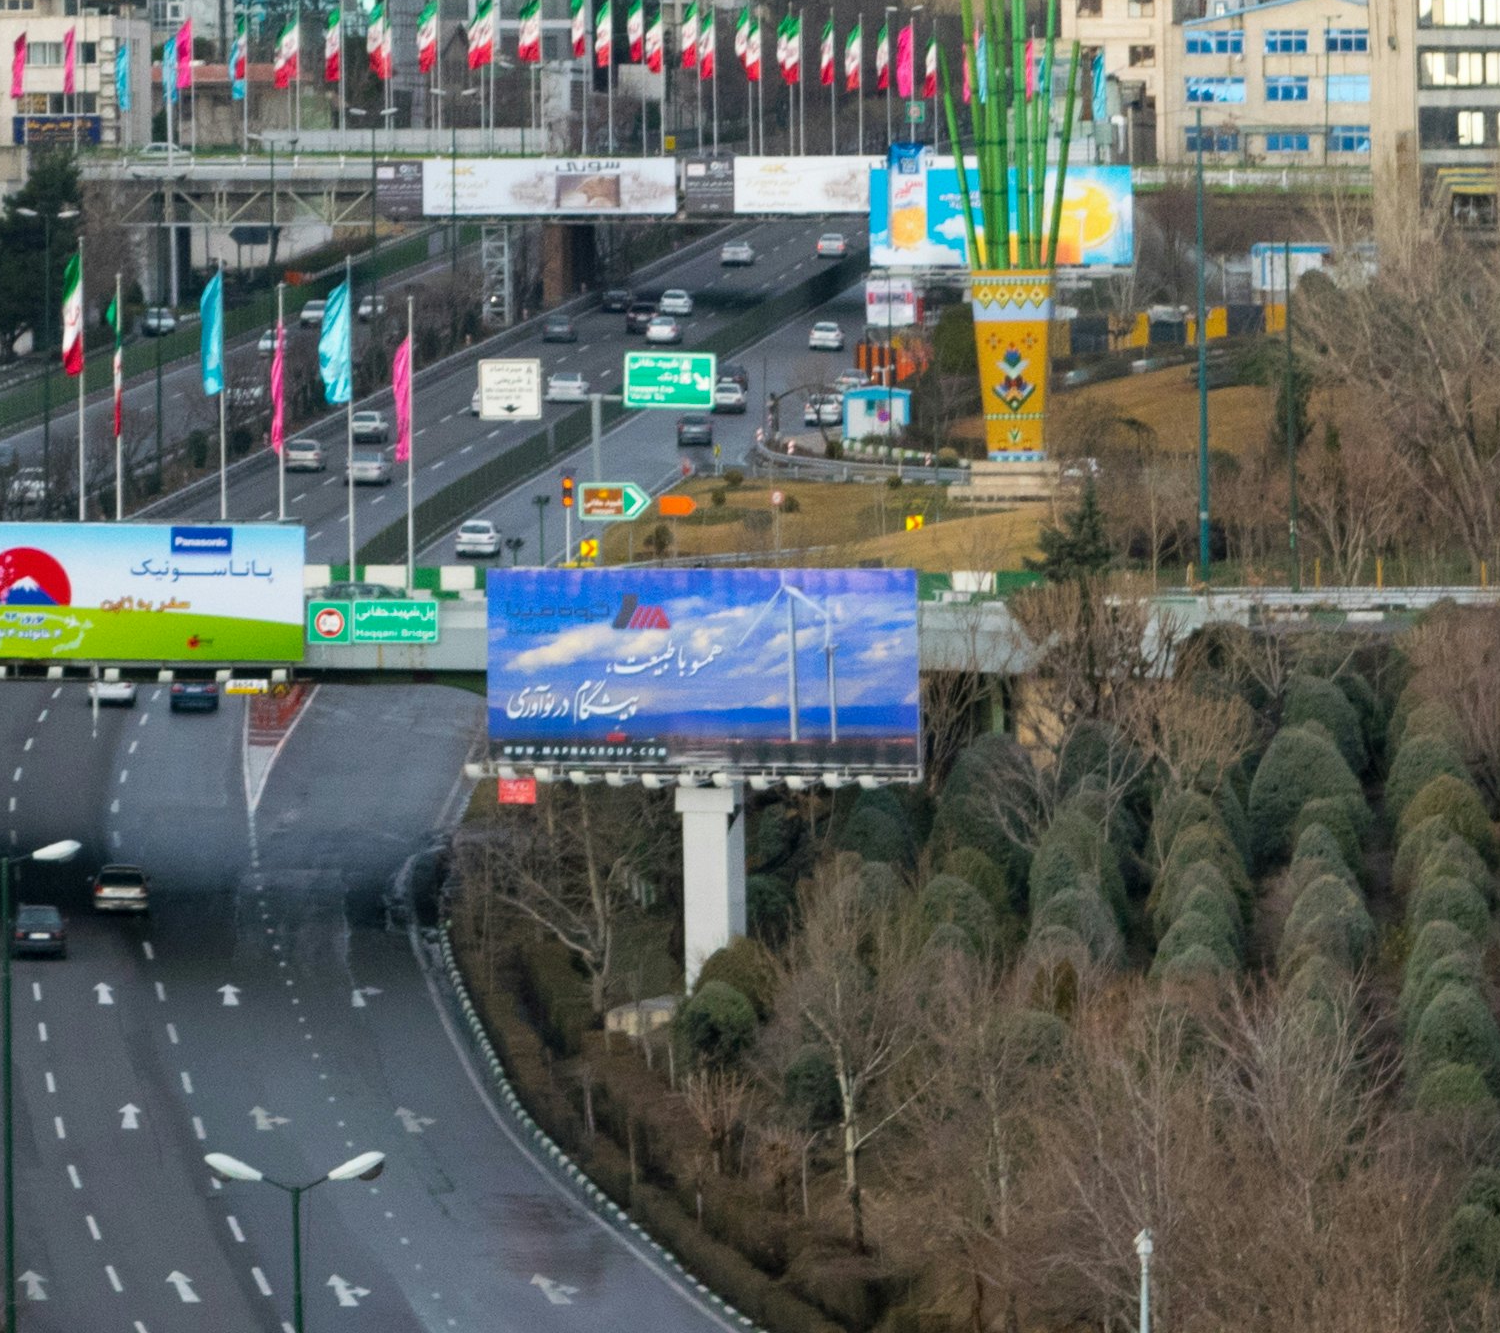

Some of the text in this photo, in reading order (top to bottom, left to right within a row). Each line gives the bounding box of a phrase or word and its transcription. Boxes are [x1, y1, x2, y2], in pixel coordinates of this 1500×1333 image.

[555, 161, 620, 172] سونی
[174, 536, 228, 547] Panasonic
[130, 559, 273, 583] پاناسونیک
[137, 597, 153, 612] به
[155, 596, 191, 612] سفر
[356, 604, 390, 621] حقانی
[390, 605, 420, 620] شهید
[677, 645, 687, 677] با
[689, 644, 722, 676] همسو
[506, 680, 640, 724] پیشگام در نوآوری
